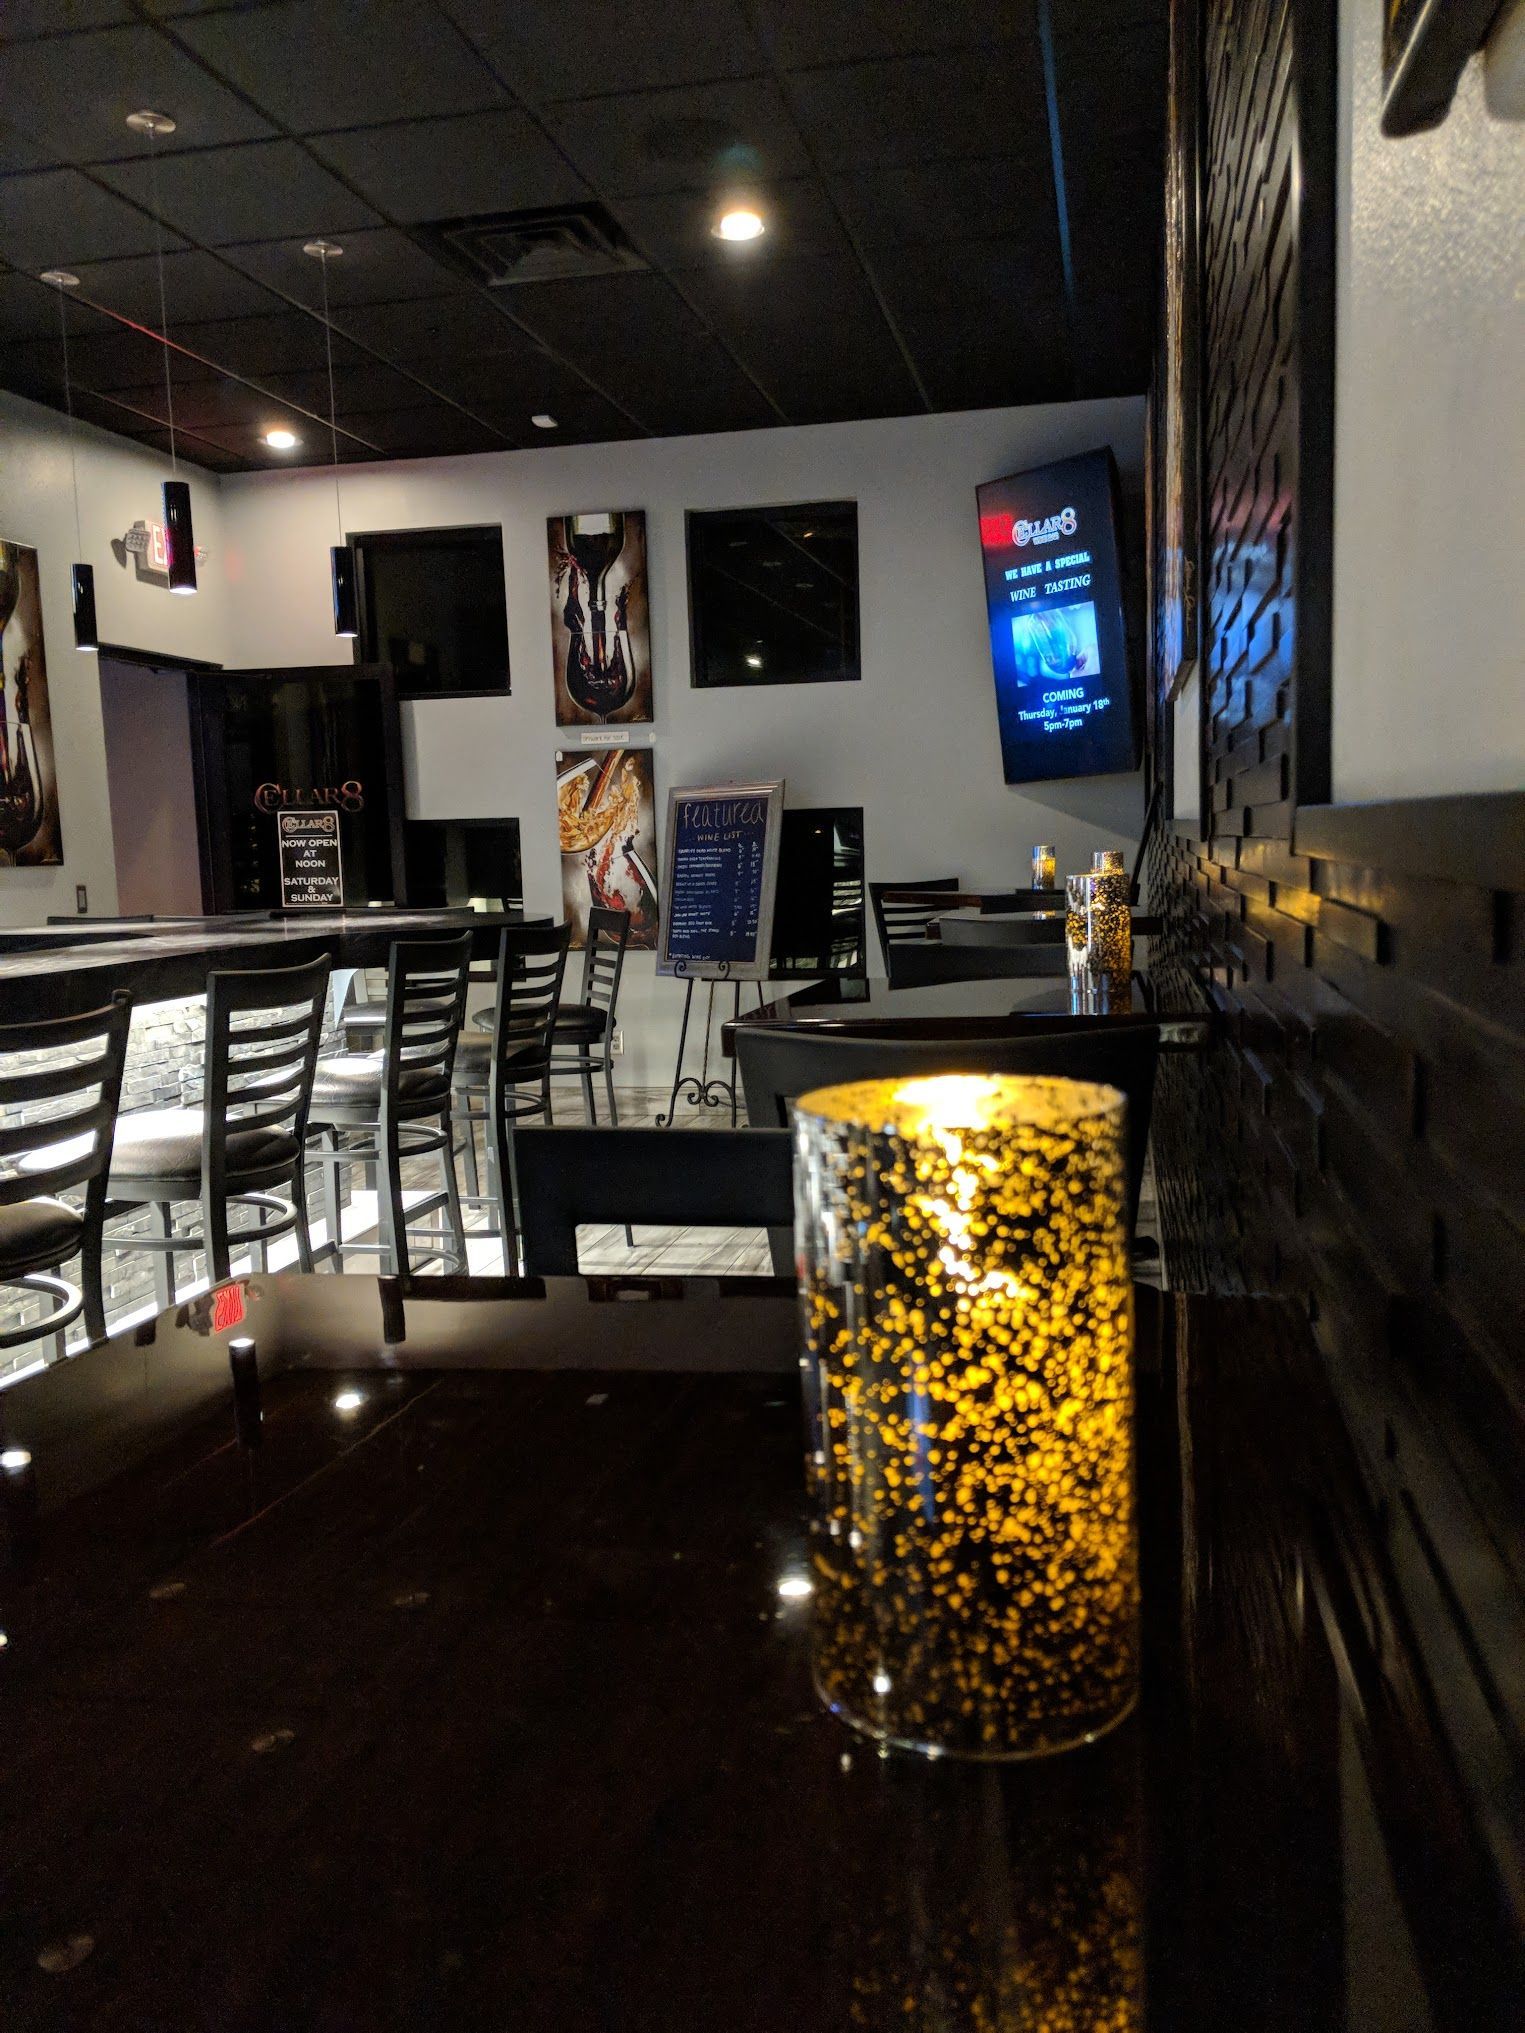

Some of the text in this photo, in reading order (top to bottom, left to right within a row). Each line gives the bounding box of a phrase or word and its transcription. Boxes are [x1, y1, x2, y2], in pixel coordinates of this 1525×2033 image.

[1005, 552, 1091, 581] WE HAVE A SPECIAL
[1010, 574, 1091, 603] WINE TASTING
[1042, 687, 1084, 703] COMING
[1018, 708, 1058, 721] Thursday,
[1093, 697, 1110, 710] 18th
[1043, 718, 1083, 732] 5pm-7pm
[697, 830, 743, 842] WINE LIST
[282, 839, 338, 848] NOW OPEN
[303, 850, 317, 858] AT
[295, 860, 326, 868] NOON
[284, 877, 339, 886] SATURDAY
[290, 894, 334, 902] SUNDAY
